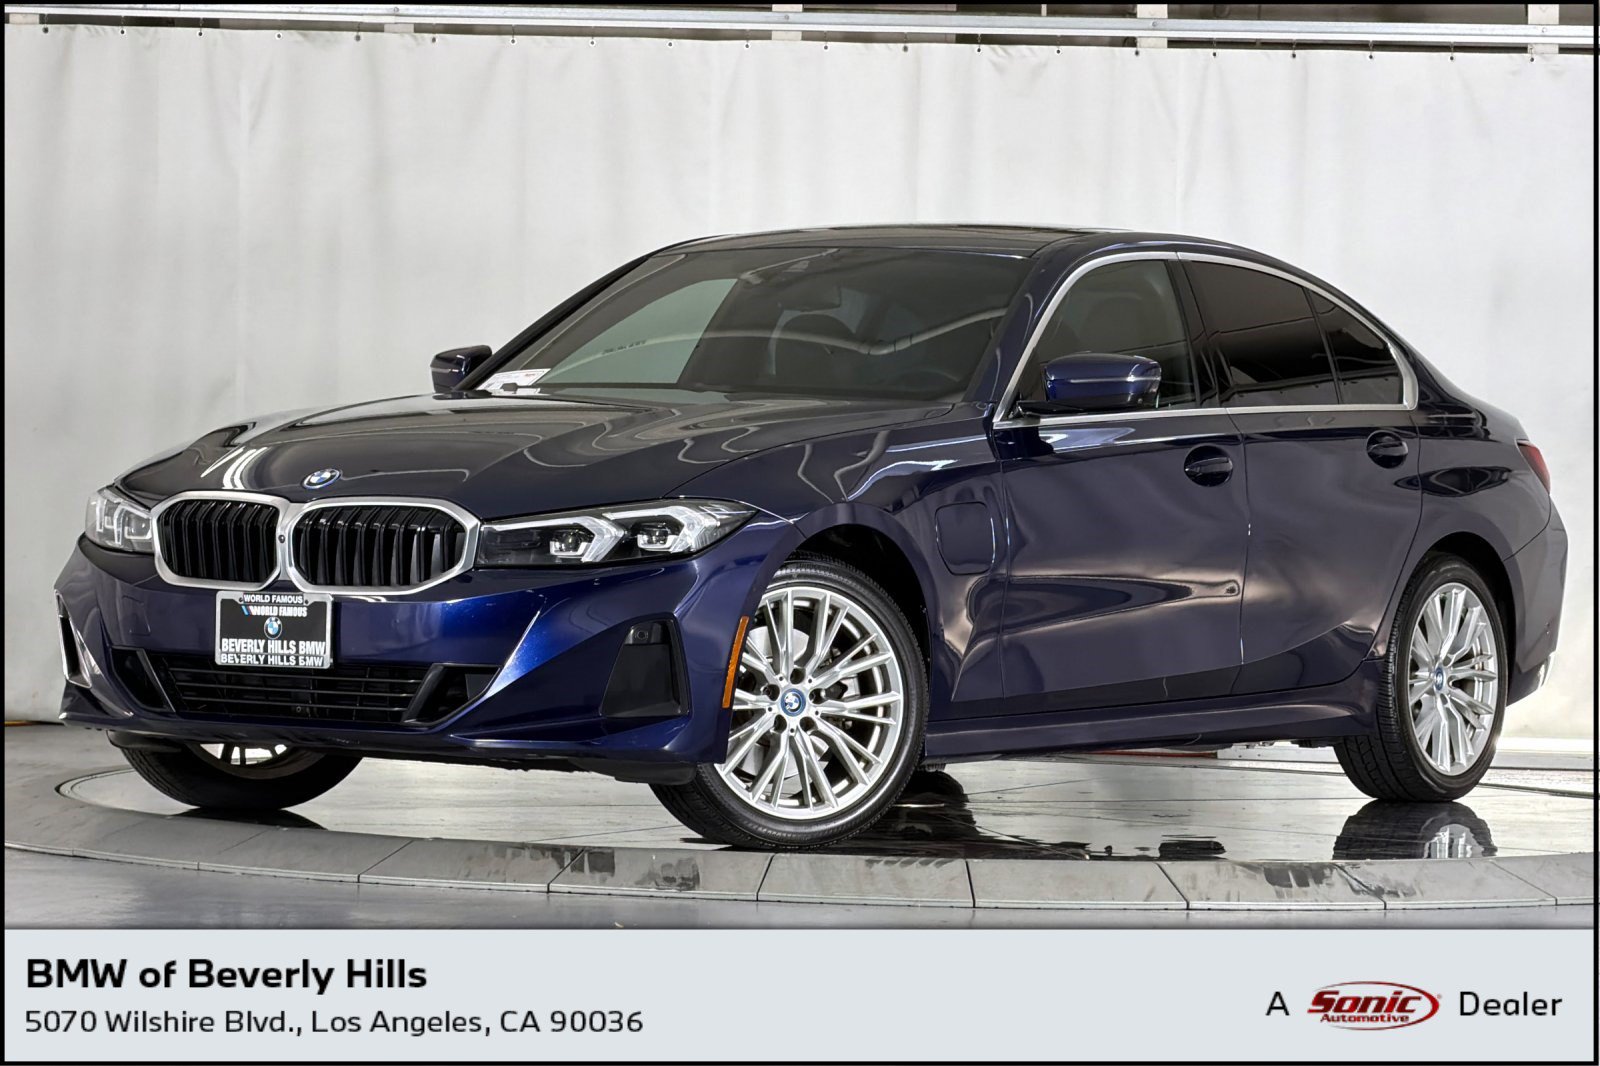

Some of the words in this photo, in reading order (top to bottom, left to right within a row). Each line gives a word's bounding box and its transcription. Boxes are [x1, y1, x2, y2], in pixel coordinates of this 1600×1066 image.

[243, 594, 270, 603] WORLD
[271, 595, 303, 604] FAMOUS
[248, 605, 279, 616] WORLD
[278, 606, 308, 617] FAMOUS
[221, 638, 265, 653] BEVERLY
[267, 639, 296, 654] HILLS
[298, 640, 326, 655] BMW
[220, 653, 265, 664] BEVERLY
[267, 655, 296, 666] HILLS
[298, 656, 324, 667] BMW
